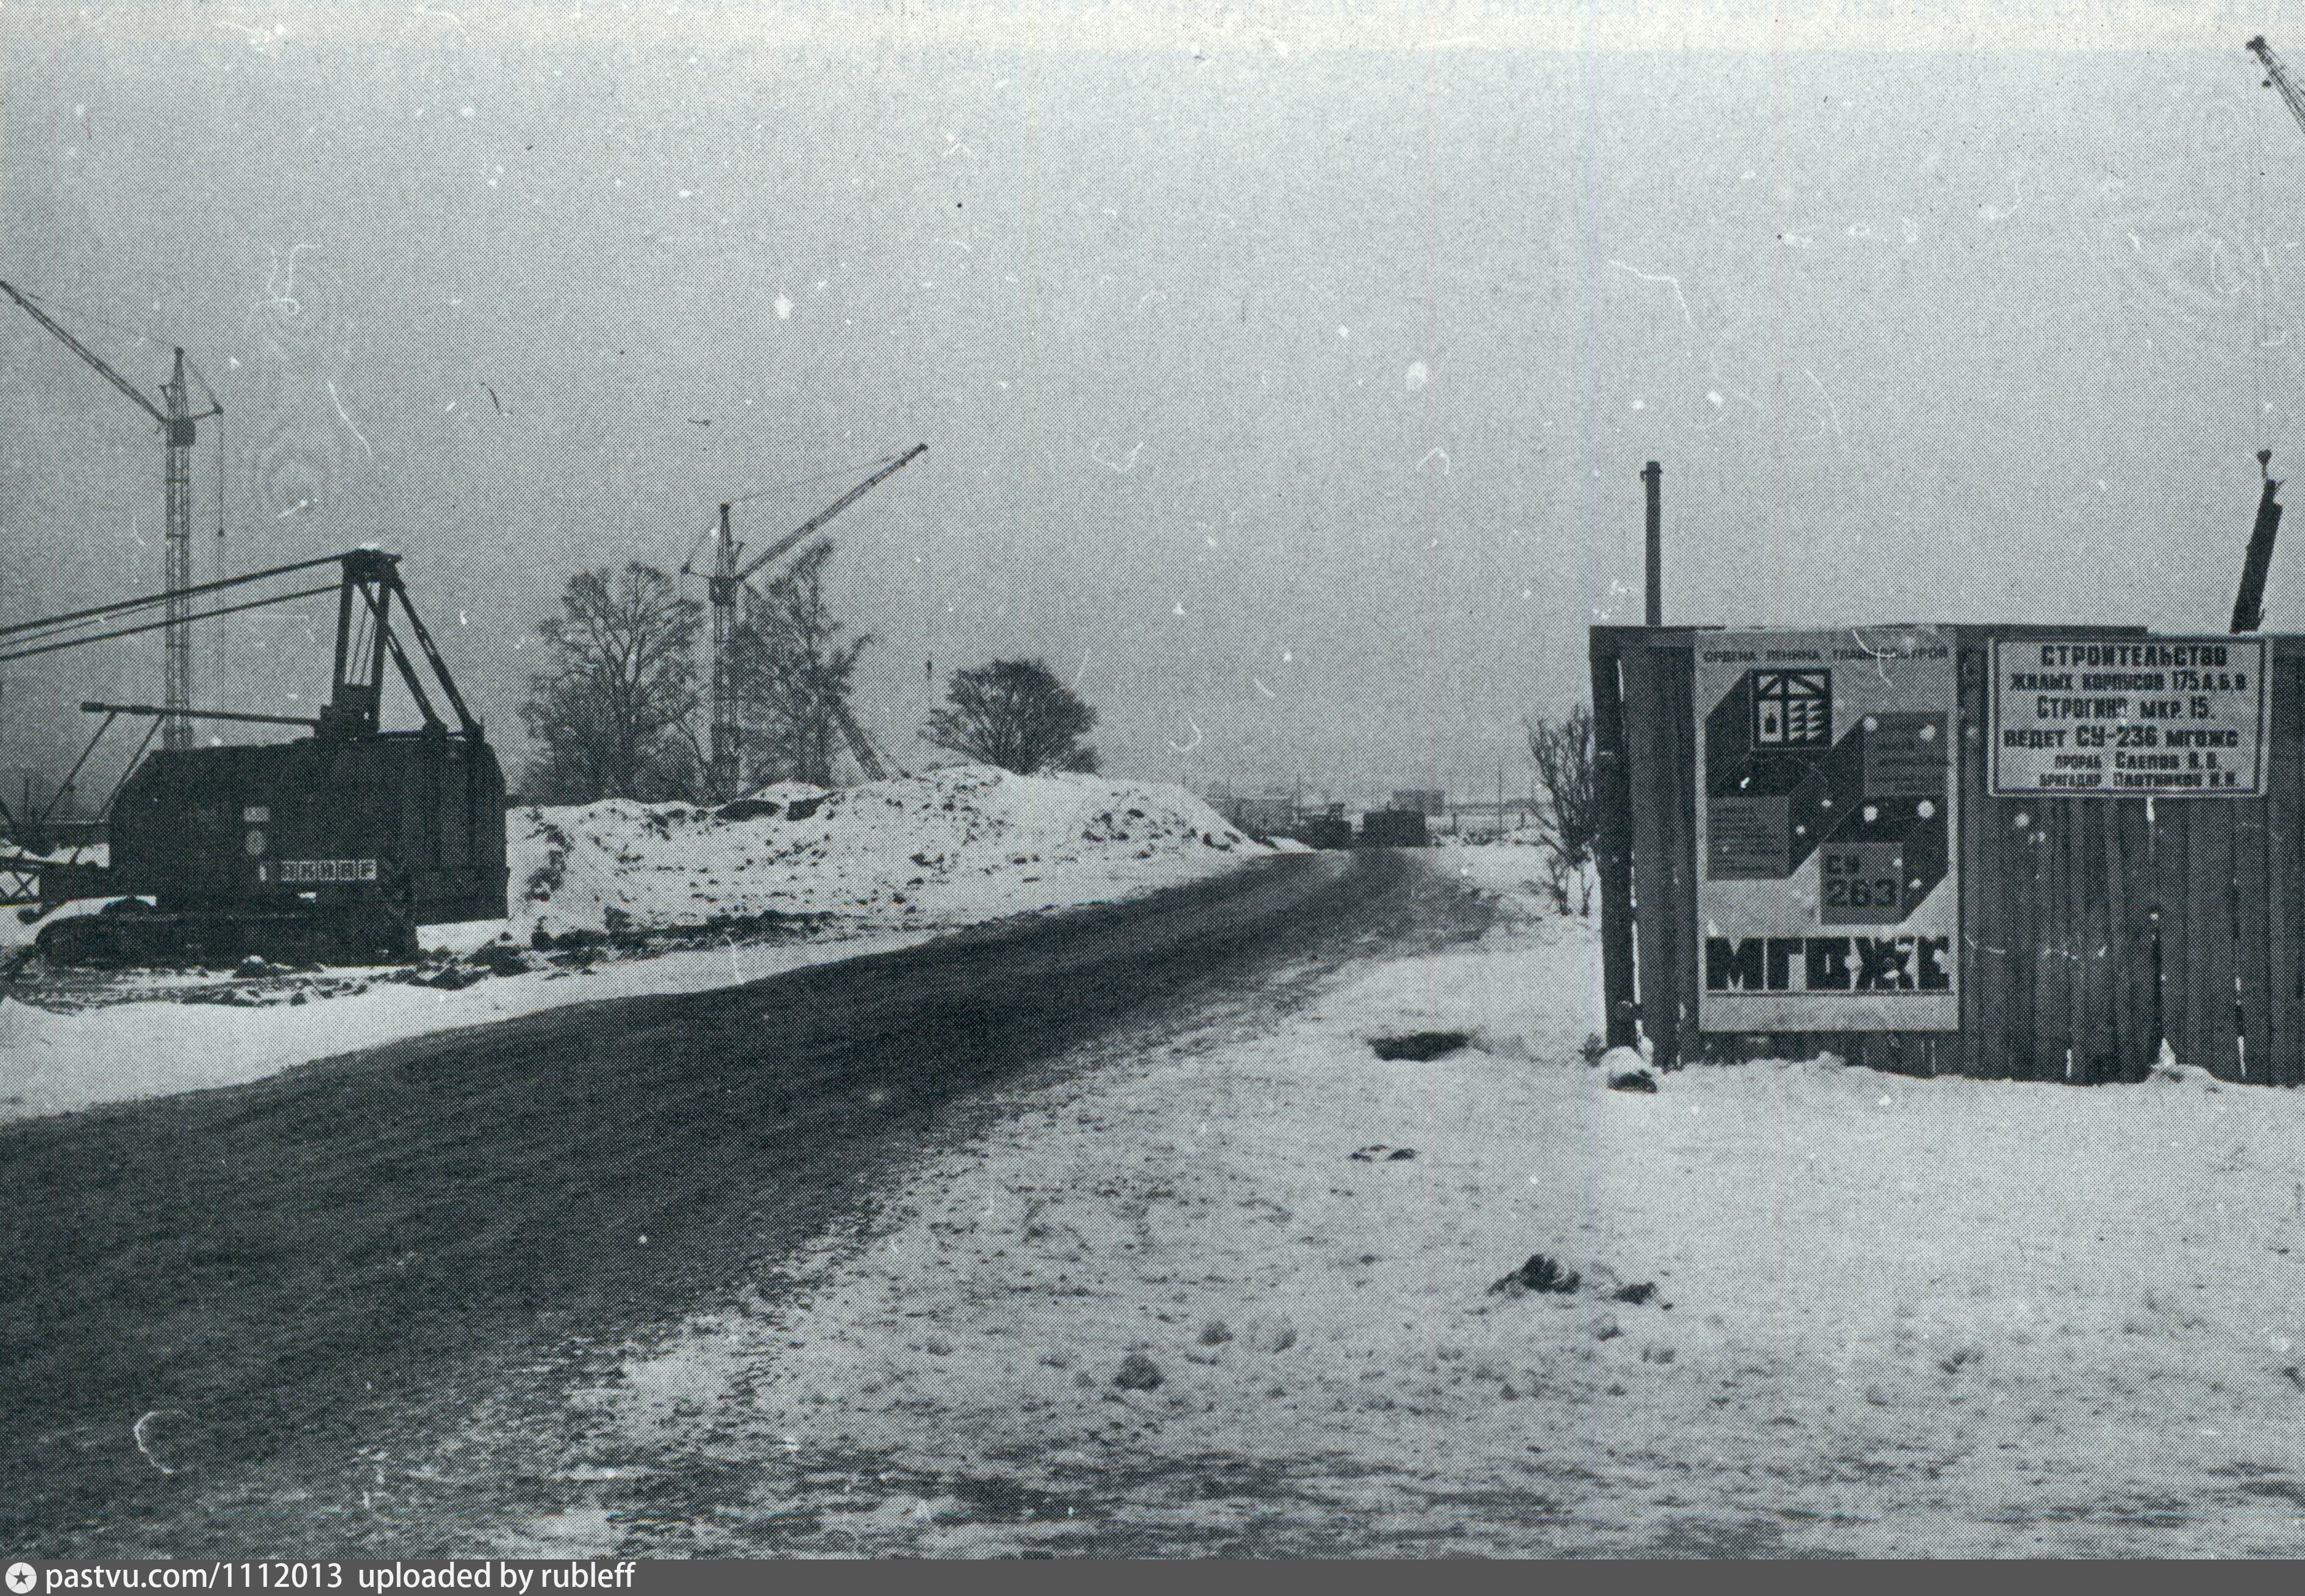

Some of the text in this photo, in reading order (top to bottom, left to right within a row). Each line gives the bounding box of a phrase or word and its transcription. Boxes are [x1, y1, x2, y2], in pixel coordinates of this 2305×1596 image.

[1703, 650, 1757, 663] ОРДЕНА
[1766, 649, 1821, 662] ЛЕНИНА
[2040, 646, 2228, 667] СТРОИТЕЛЬСТВО
[2009, 674, 2073, 691] ЖИЛЫХ
[2082, 674, 2164, 691] КОРПУСОВ
[2004, 730, 2067, 749] ВЕДЕТ
[2076, 725, 2158, 748] СУ-236
[2054, 755, 2102, 770] ПРОРАБ
[1826, 854, 1860, 874] СУ
[1826, 878, 1897, 907] 263
[1706, 936, 1950, 991] МГОЖС
